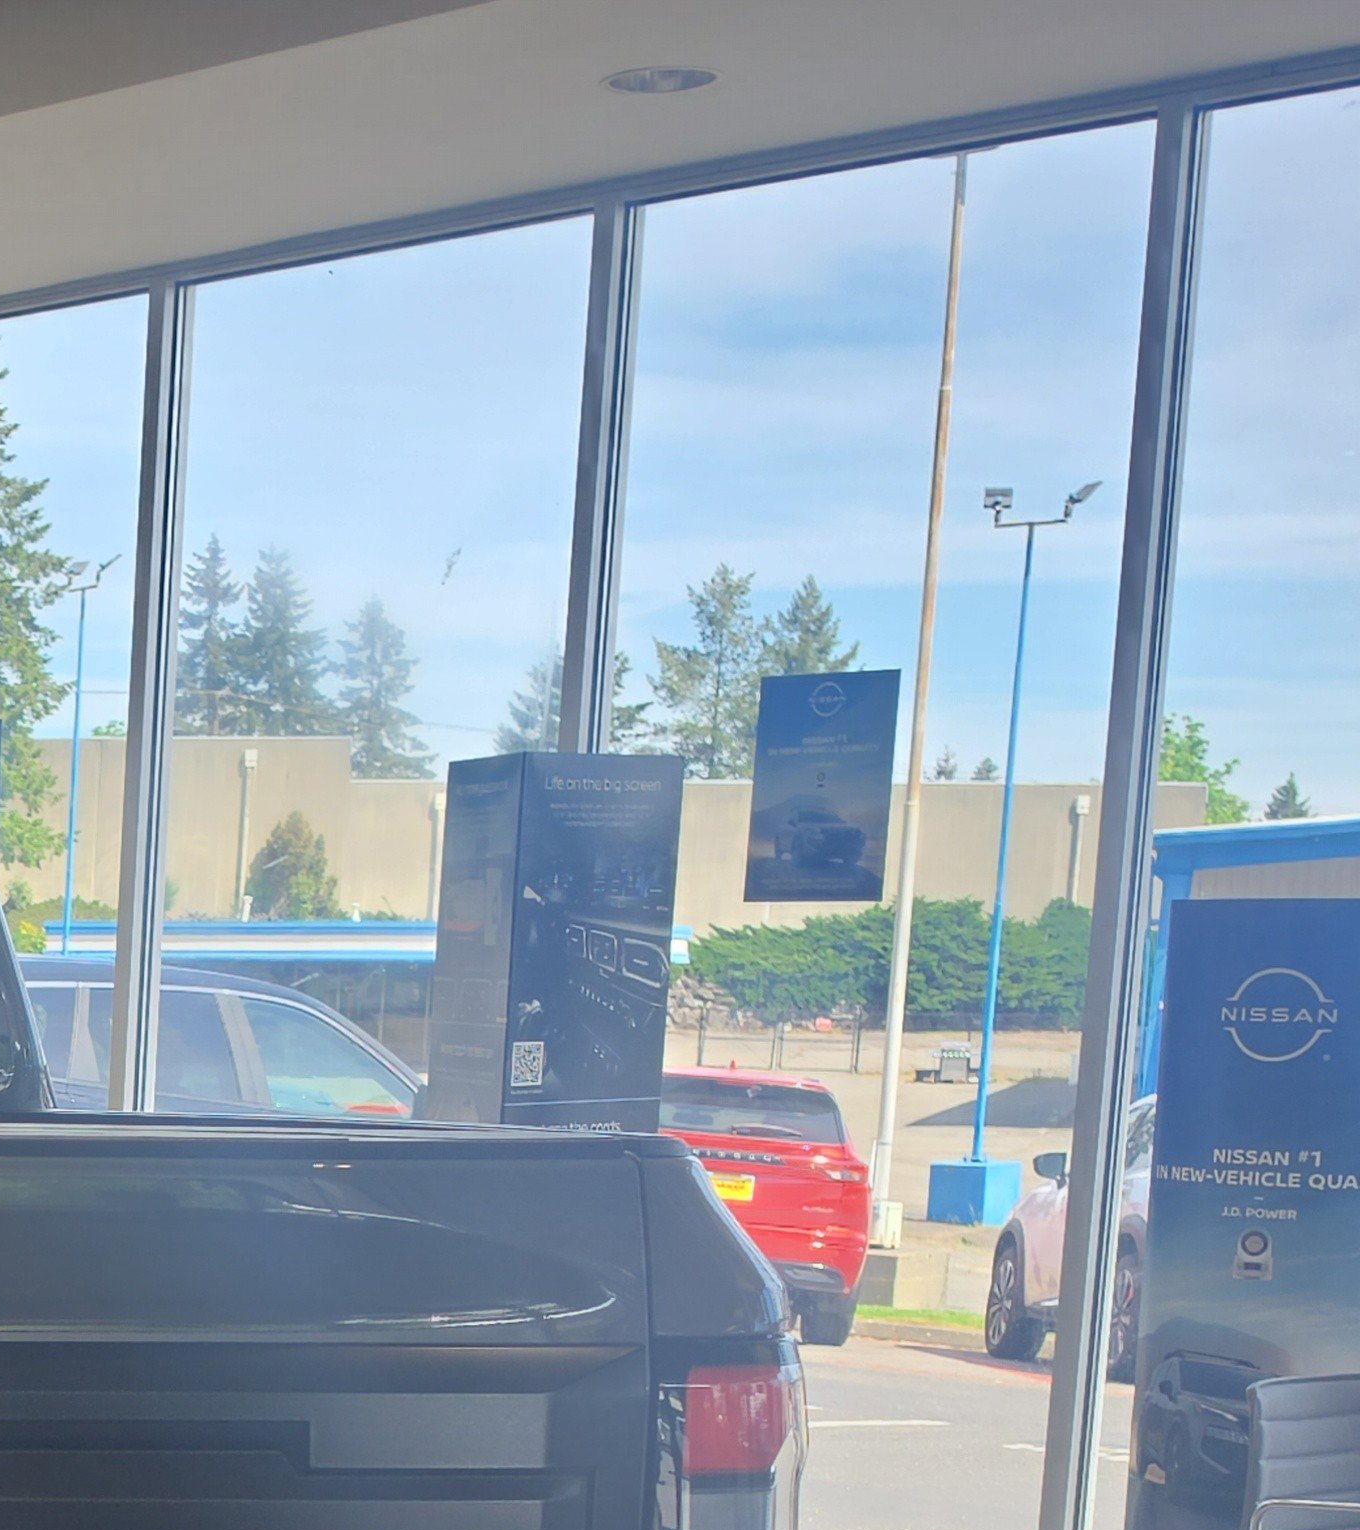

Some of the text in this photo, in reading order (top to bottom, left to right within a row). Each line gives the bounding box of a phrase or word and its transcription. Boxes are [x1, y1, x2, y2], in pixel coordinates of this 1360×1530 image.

[1221, 1007, 1338, 1023] NISSAN
[1213, 1148, 1322, 1168] NISSAN #1
[1156, 1165, 1168, 1180] IN
[1172, 1166, 1301, 1188] NEW-VEHICLE
[1246, 1208, 1298, 1220] POWER
